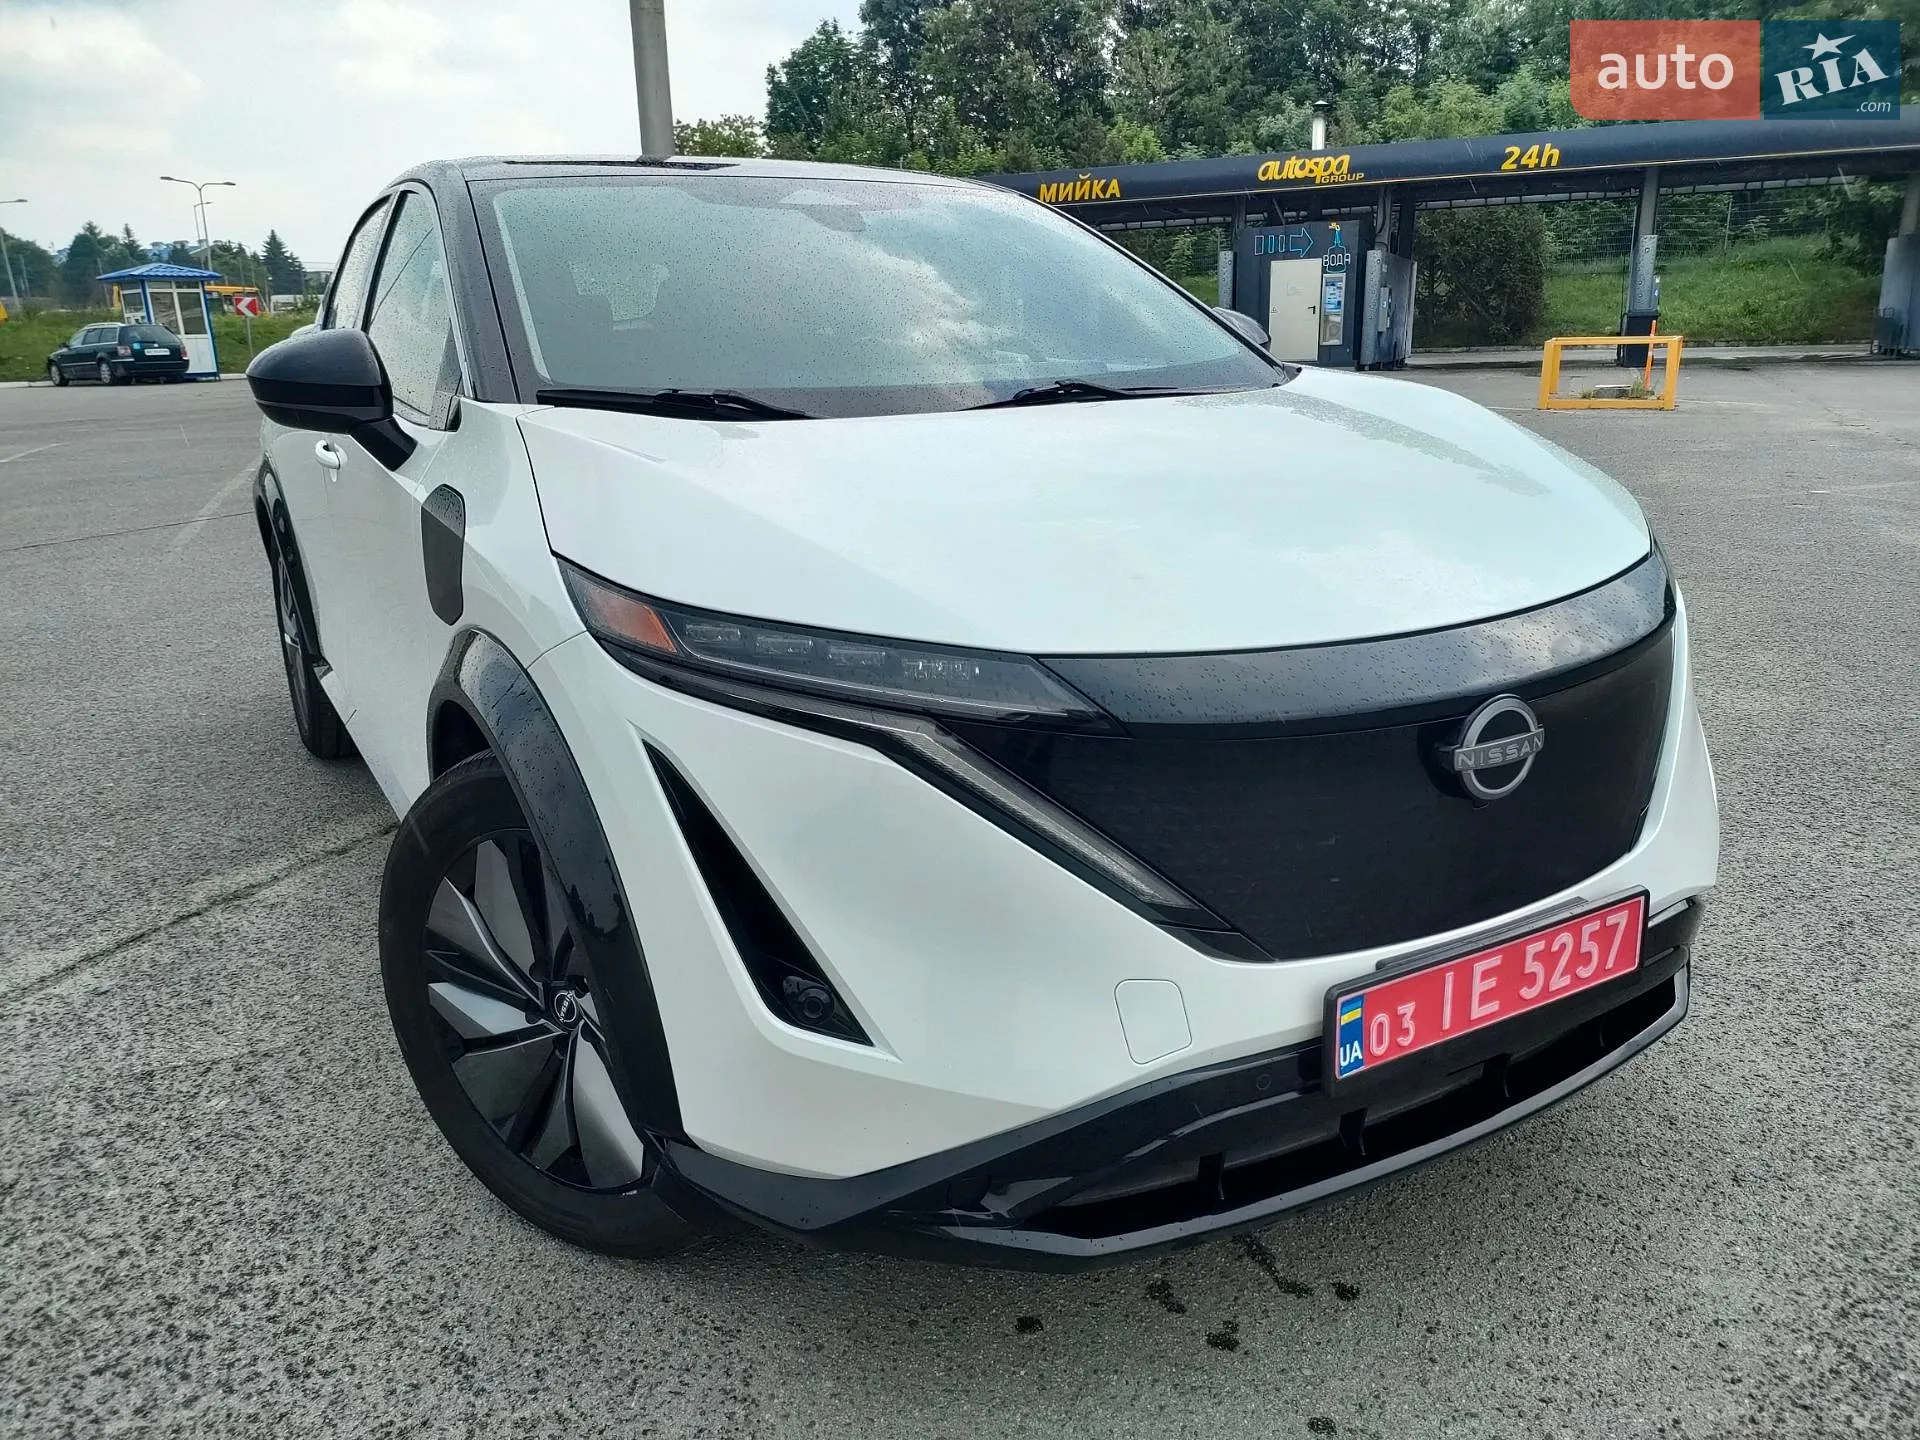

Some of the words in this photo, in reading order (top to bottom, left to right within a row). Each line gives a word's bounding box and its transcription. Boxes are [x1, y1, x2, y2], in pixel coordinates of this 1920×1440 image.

[1257, 154, 1350, 184] autospa
[1501, 143, 1560, 170] 24h
[1040, 172, 1120, 202] МИЙКА
[1321, 172, 1364, 184] GROUP
[1322, 253, 1350, 267] ВОДА
[1457, 733, 1544, 767] NISSAN
[1369, 1001, 1416, 1056] 03
[1518, 910, 1629, 1000] 5257
[1339, 1040, 1363, 1067] UA
